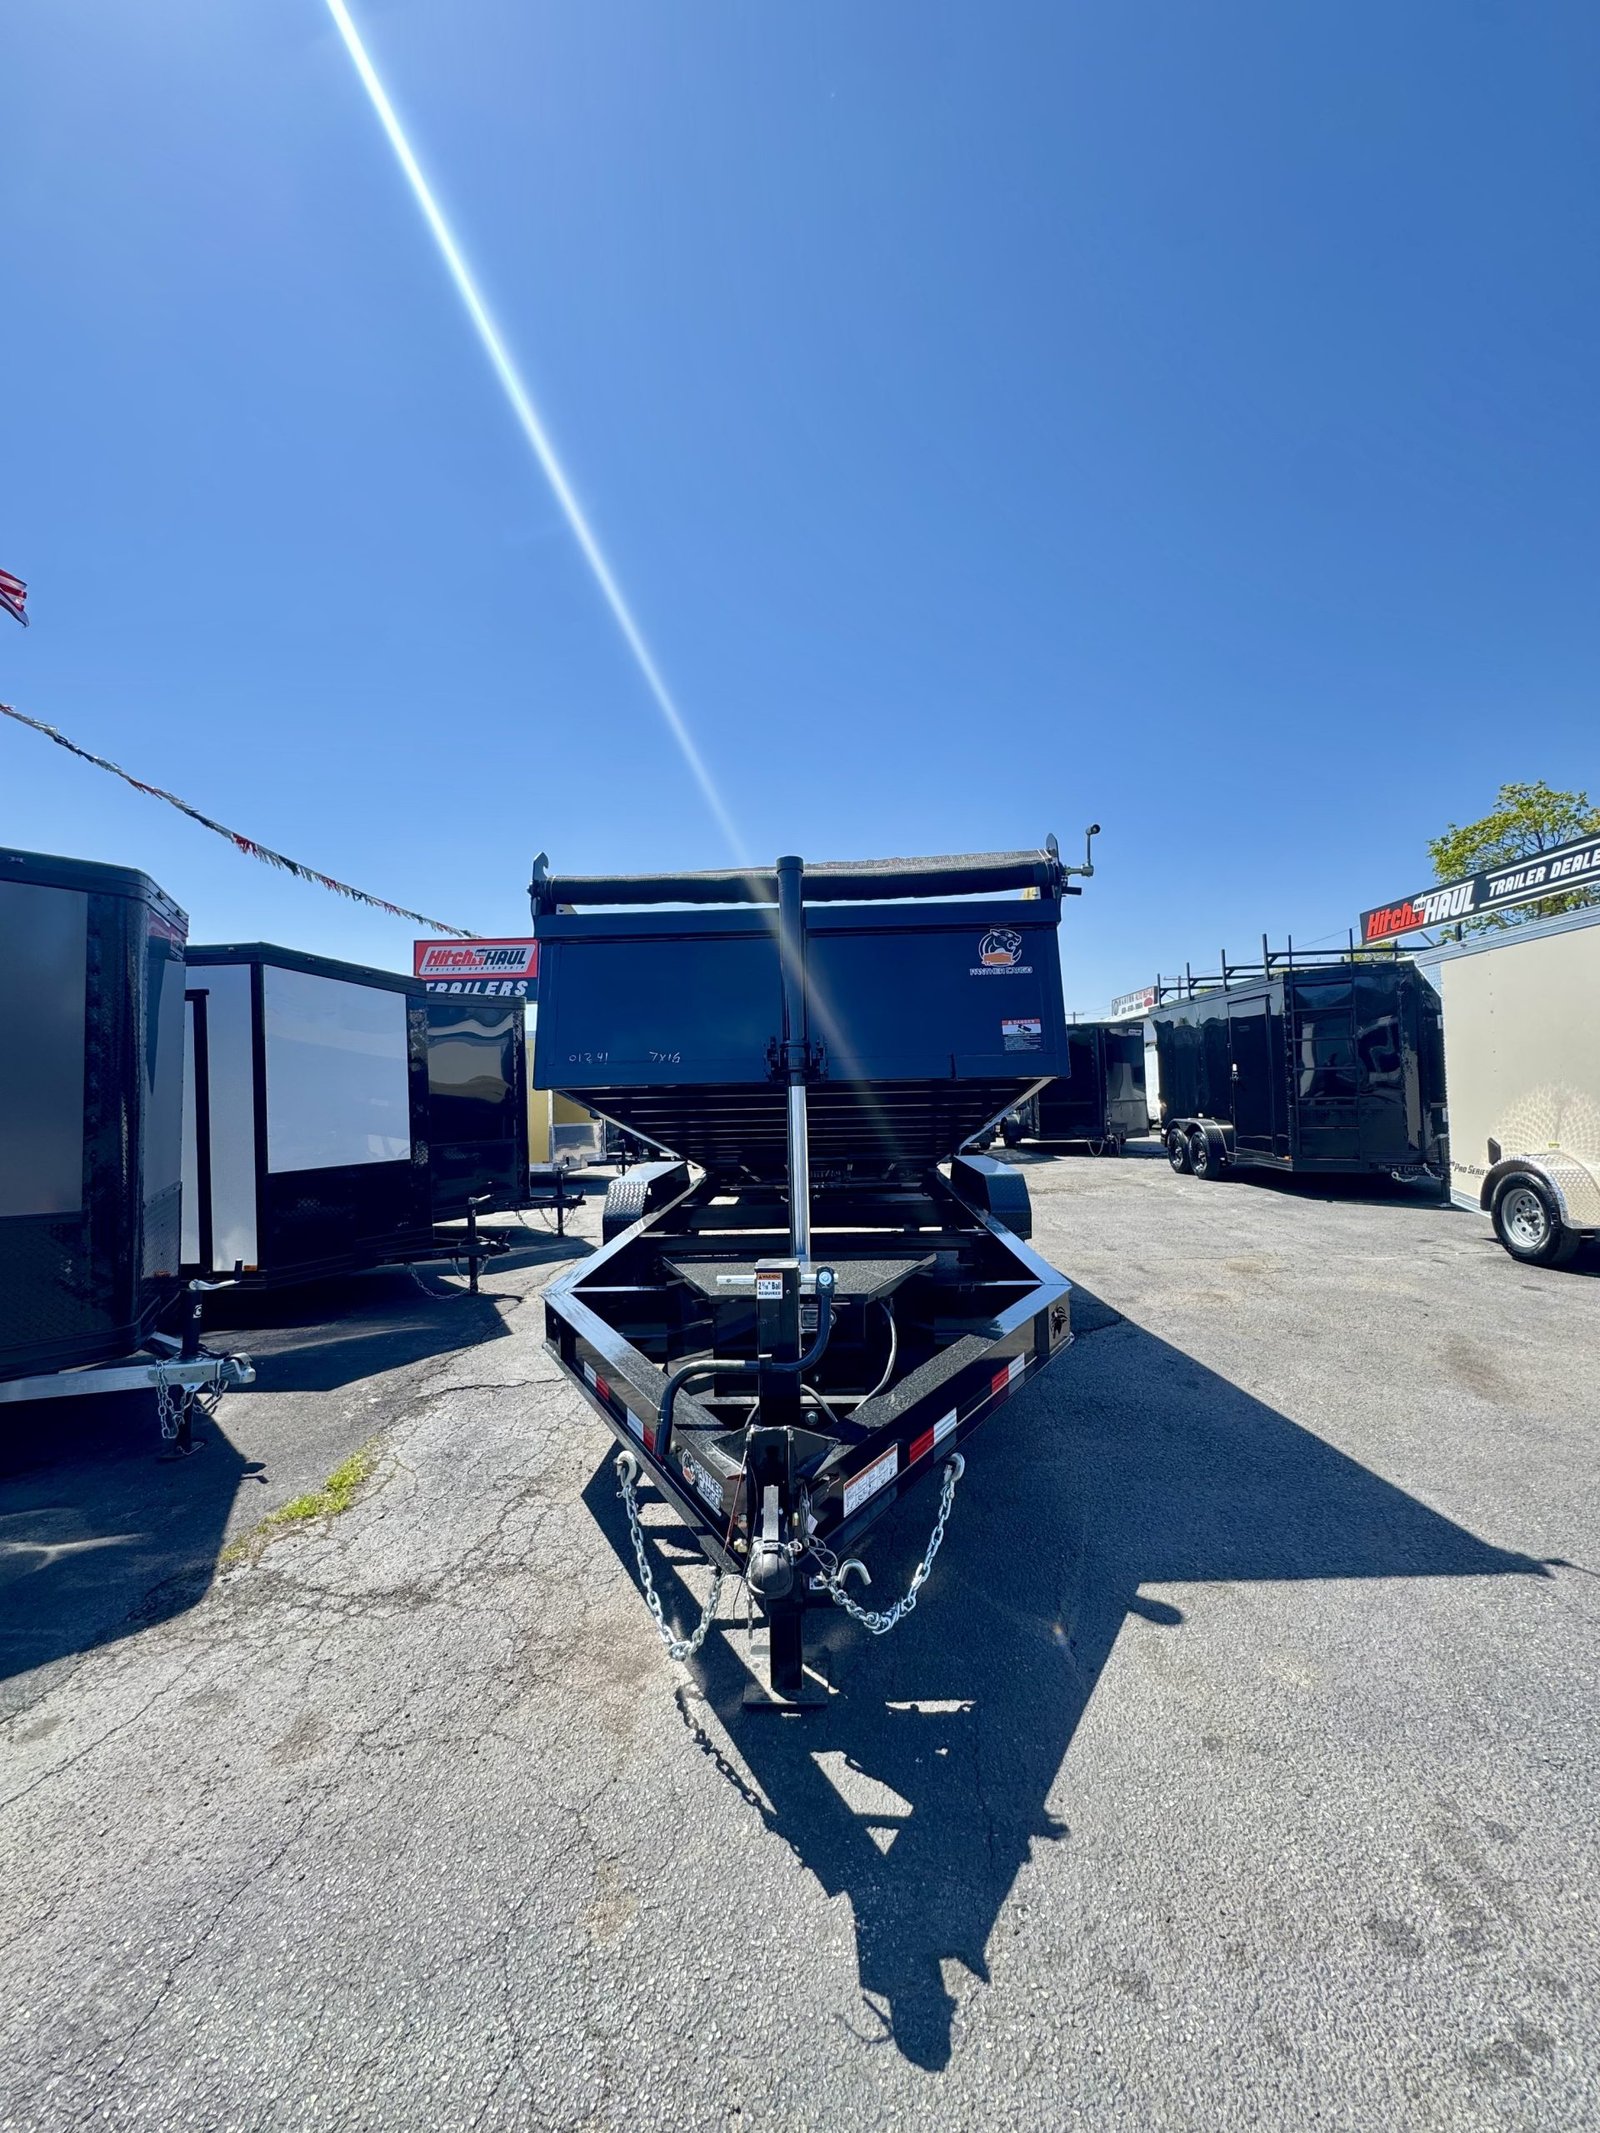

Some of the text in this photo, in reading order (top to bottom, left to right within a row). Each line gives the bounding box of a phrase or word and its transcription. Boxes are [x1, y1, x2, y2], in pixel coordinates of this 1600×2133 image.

[1489, 866, 1547, 897] TRAILER
[1367, 902, 1413, 937] Hitch
[1423, 885, 1475, 924] HAUL
[427, 950, 526, 966] Hitch HAUL
[425, 981, 528, 996] TRAILERS
